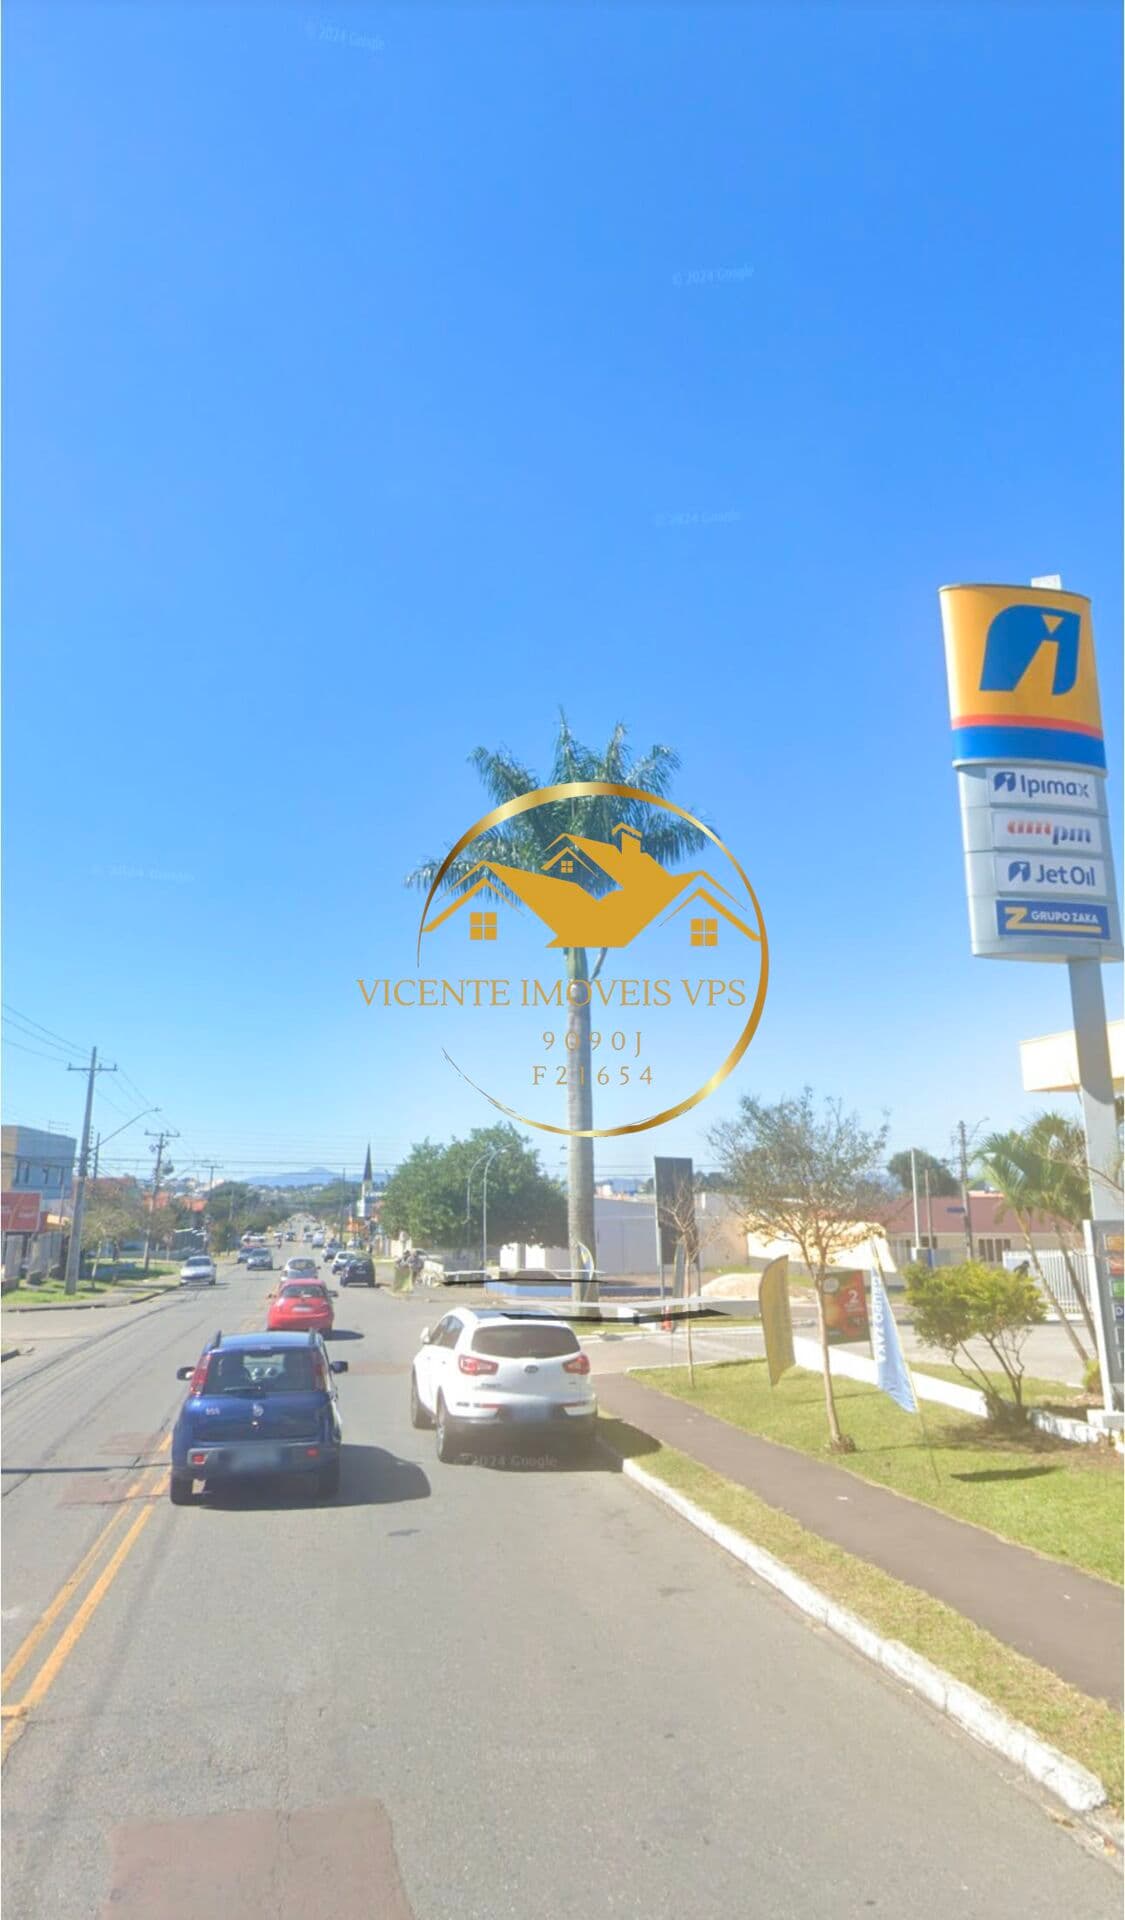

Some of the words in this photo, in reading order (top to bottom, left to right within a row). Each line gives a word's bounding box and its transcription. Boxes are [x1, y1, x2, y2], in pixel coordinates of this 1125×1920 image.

[1020, 774, 1090, 798] Ipimax
[1031, 911, 1070, 923] GRUPO
[1071, 912, 1099, 925] ZAKA
